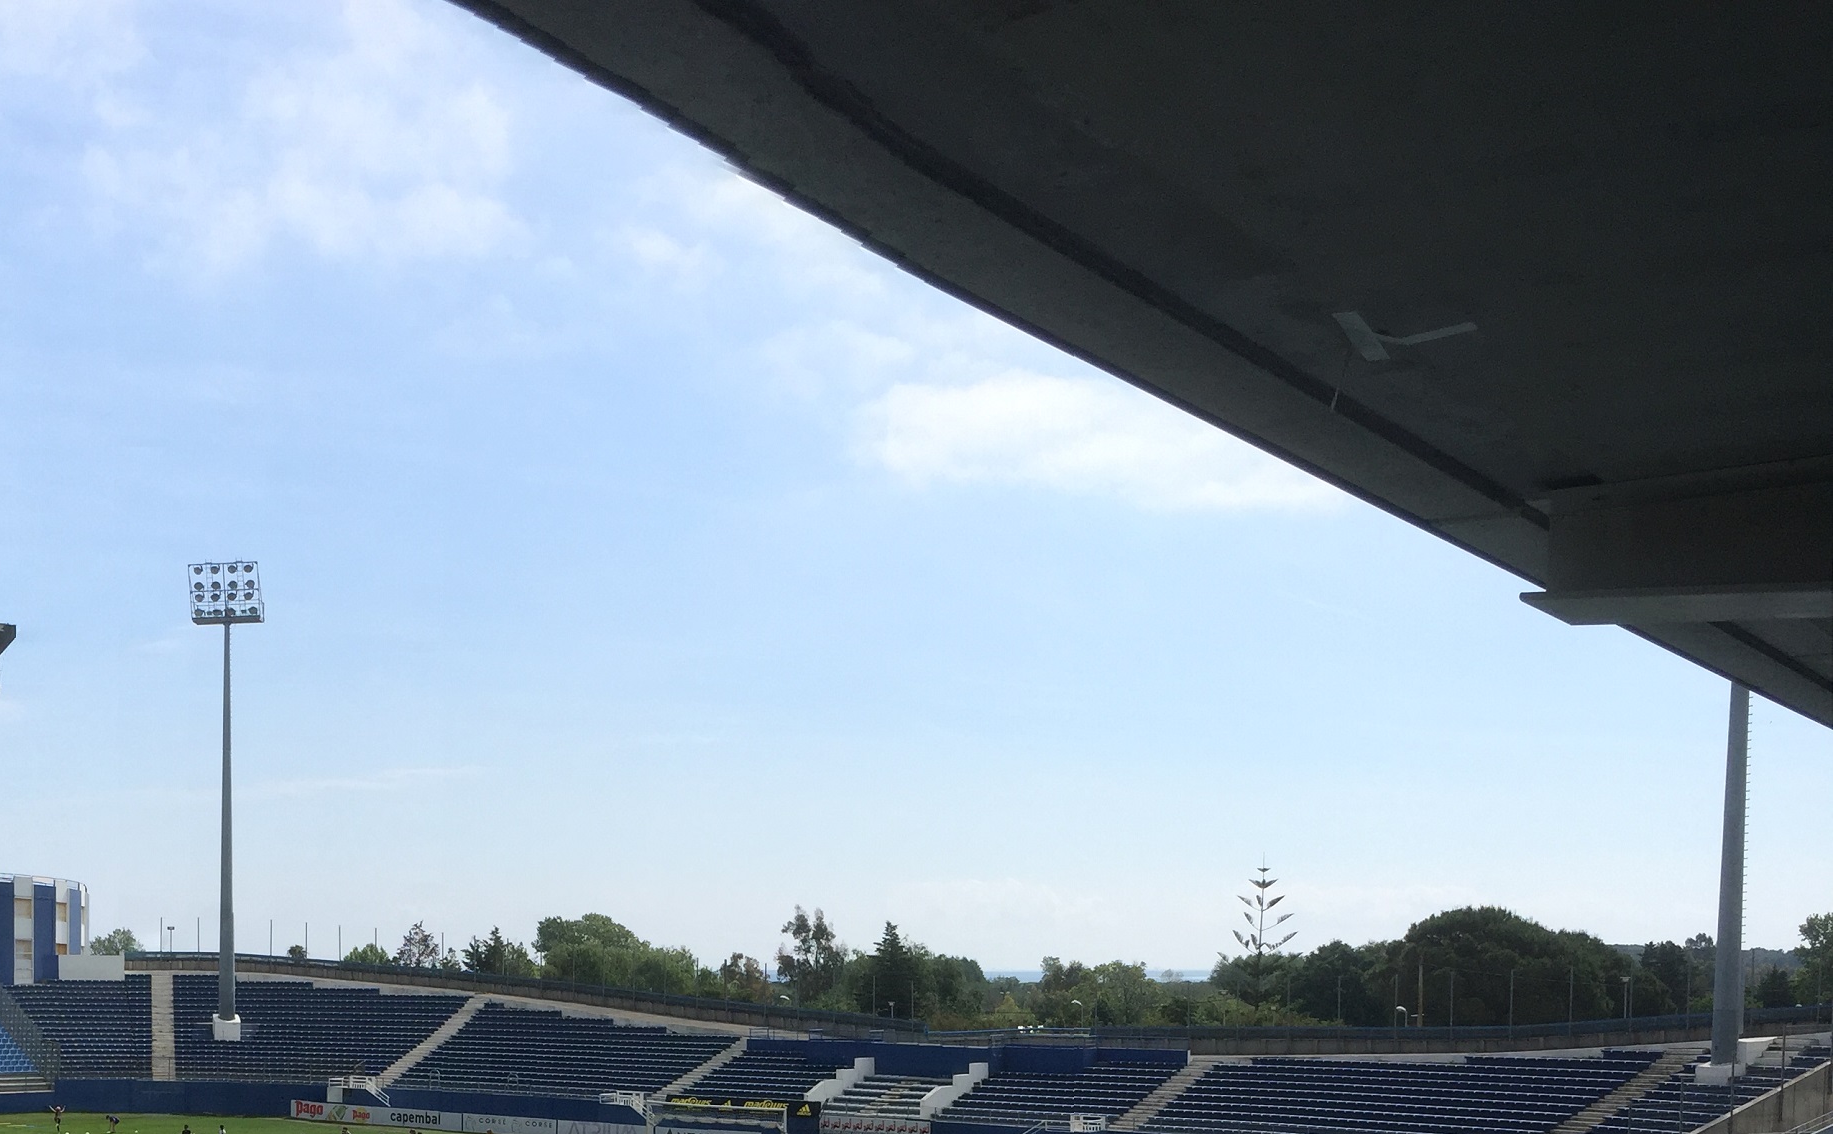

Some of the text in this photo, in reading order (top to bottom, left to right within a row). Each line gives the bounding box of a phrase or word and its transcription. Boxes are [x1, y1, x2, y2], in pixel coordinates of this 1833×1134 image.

[390, 1112, 441, 1126] capembal
[479, 1118, 507, 1126] CORSE
[525, 1120, 553, 1129] CORSE
